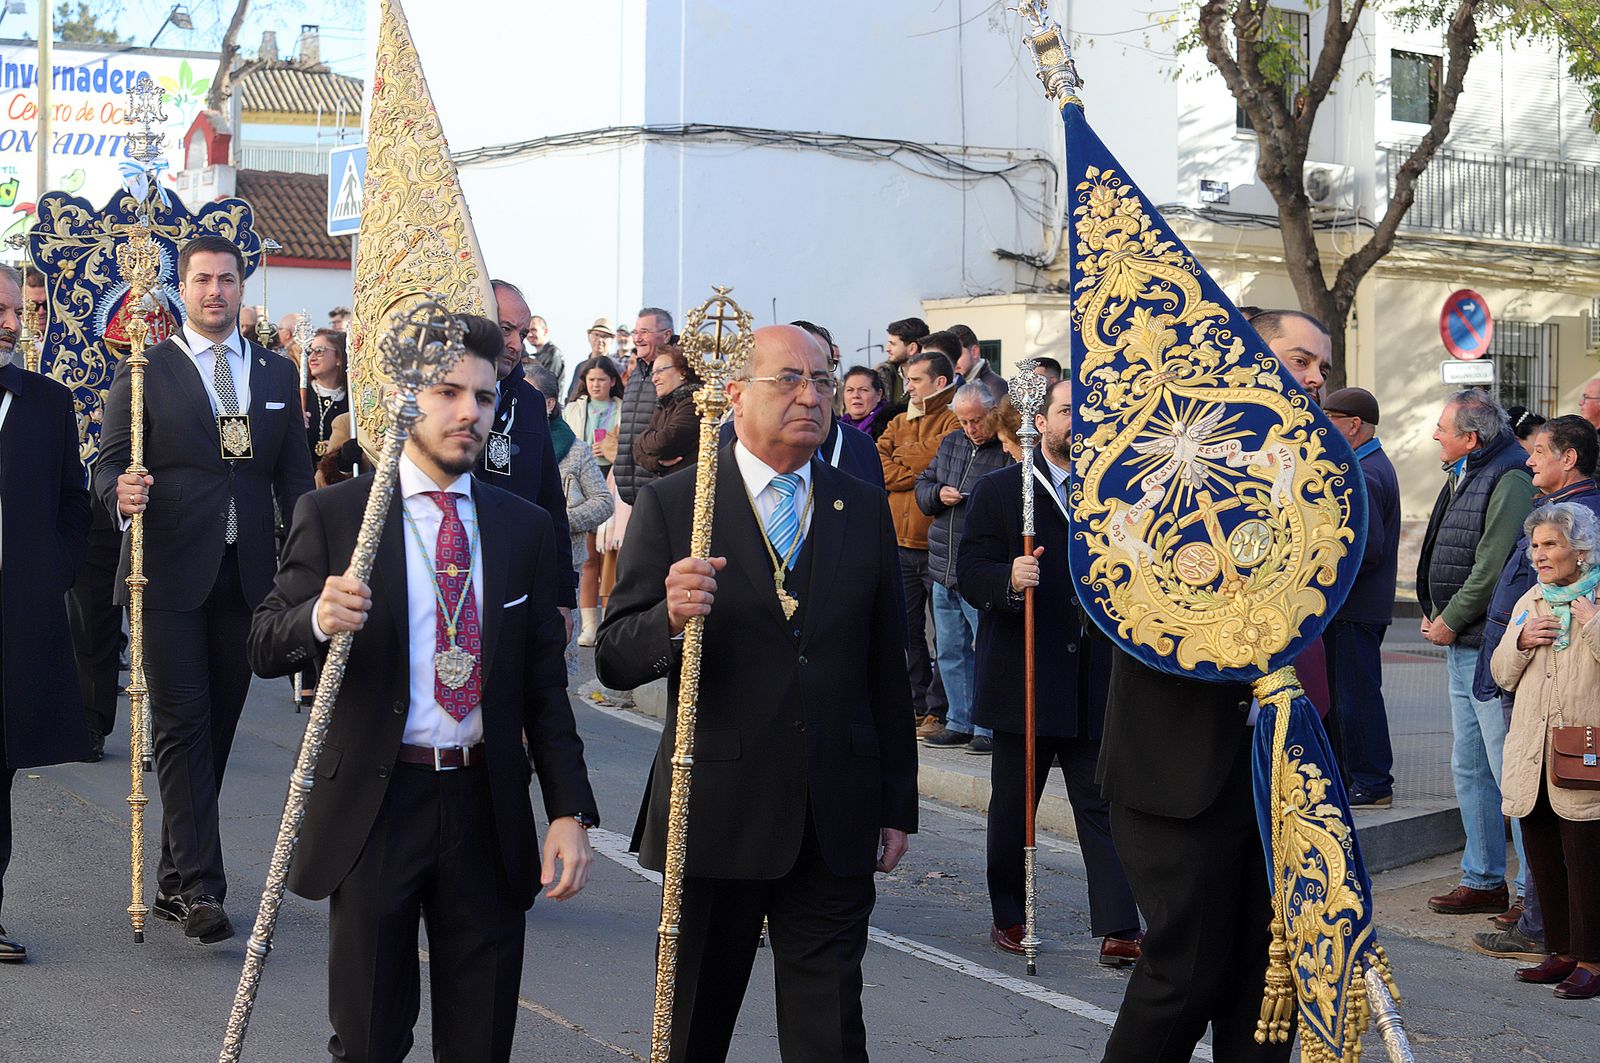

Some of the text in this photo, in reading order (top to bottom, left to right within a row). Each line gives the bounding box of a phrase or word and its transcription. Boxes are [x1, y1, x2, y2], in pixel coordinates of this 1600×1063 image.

[8, 93, 72, 122] Cenro
[75, 100, 95, 121] de
[0, 129, 132, 158] ONADIT
[1112, 524, 1126, 542] EGO
[1145, 459, 1178, 486] RESUR
[1197, 443, 1238, 454] RECTIO
[1278, 447, 1292, 470] VITA
